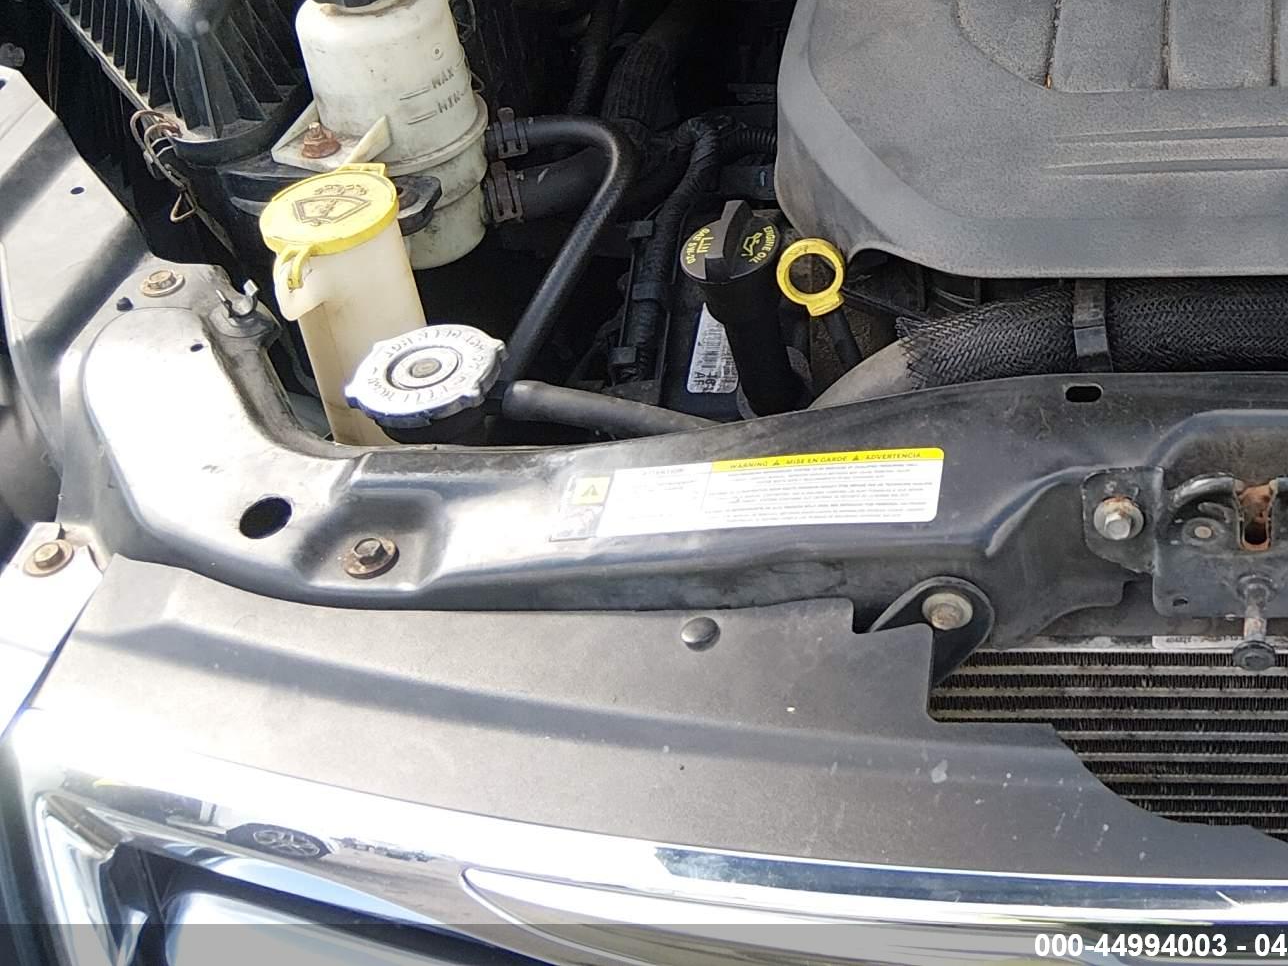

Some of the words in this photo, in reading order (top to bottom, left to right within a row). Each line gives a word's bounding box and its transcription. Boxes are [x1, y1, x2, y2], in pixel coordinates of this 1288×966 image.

[763, 225, 777, 251] ENGINE
[749, 251, 768, 264] OIL
[730, 461, 768, 469] WARNING
[786, 457, 805, 465] MISE
[807, 456, 818, 464] EN
[820, 455, 847, 463] GARDE
[866, 452, 921, 461] ADVERTENCIA
